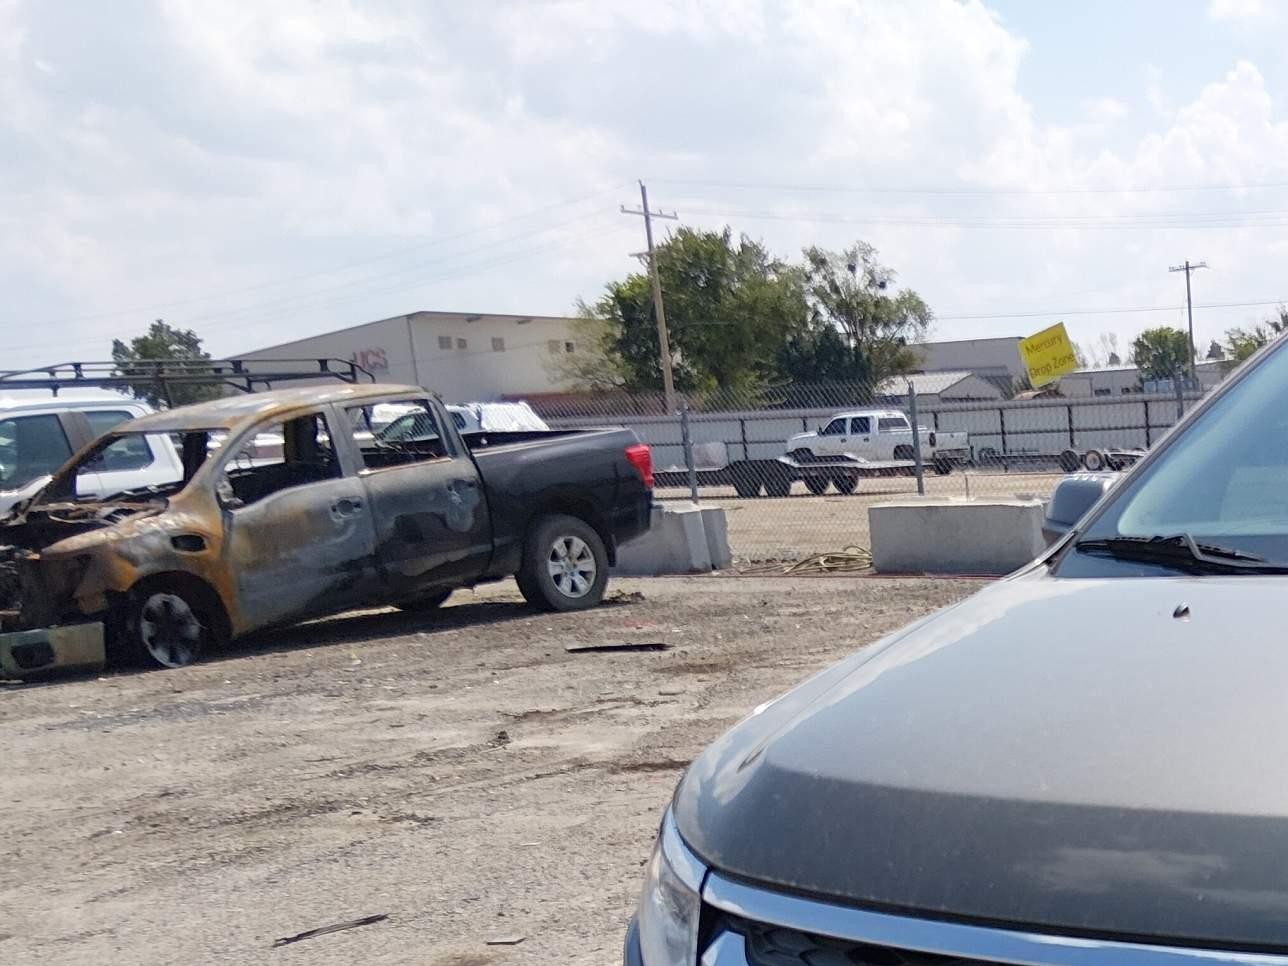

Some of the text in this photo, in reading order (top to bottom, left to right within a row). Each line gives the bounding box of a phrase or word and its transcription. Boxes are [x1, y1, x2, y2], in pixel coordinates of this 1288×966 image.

[1025, 335, 1064, 356] Mercury
[1029, 353, 1075, 379] Drop Zone
